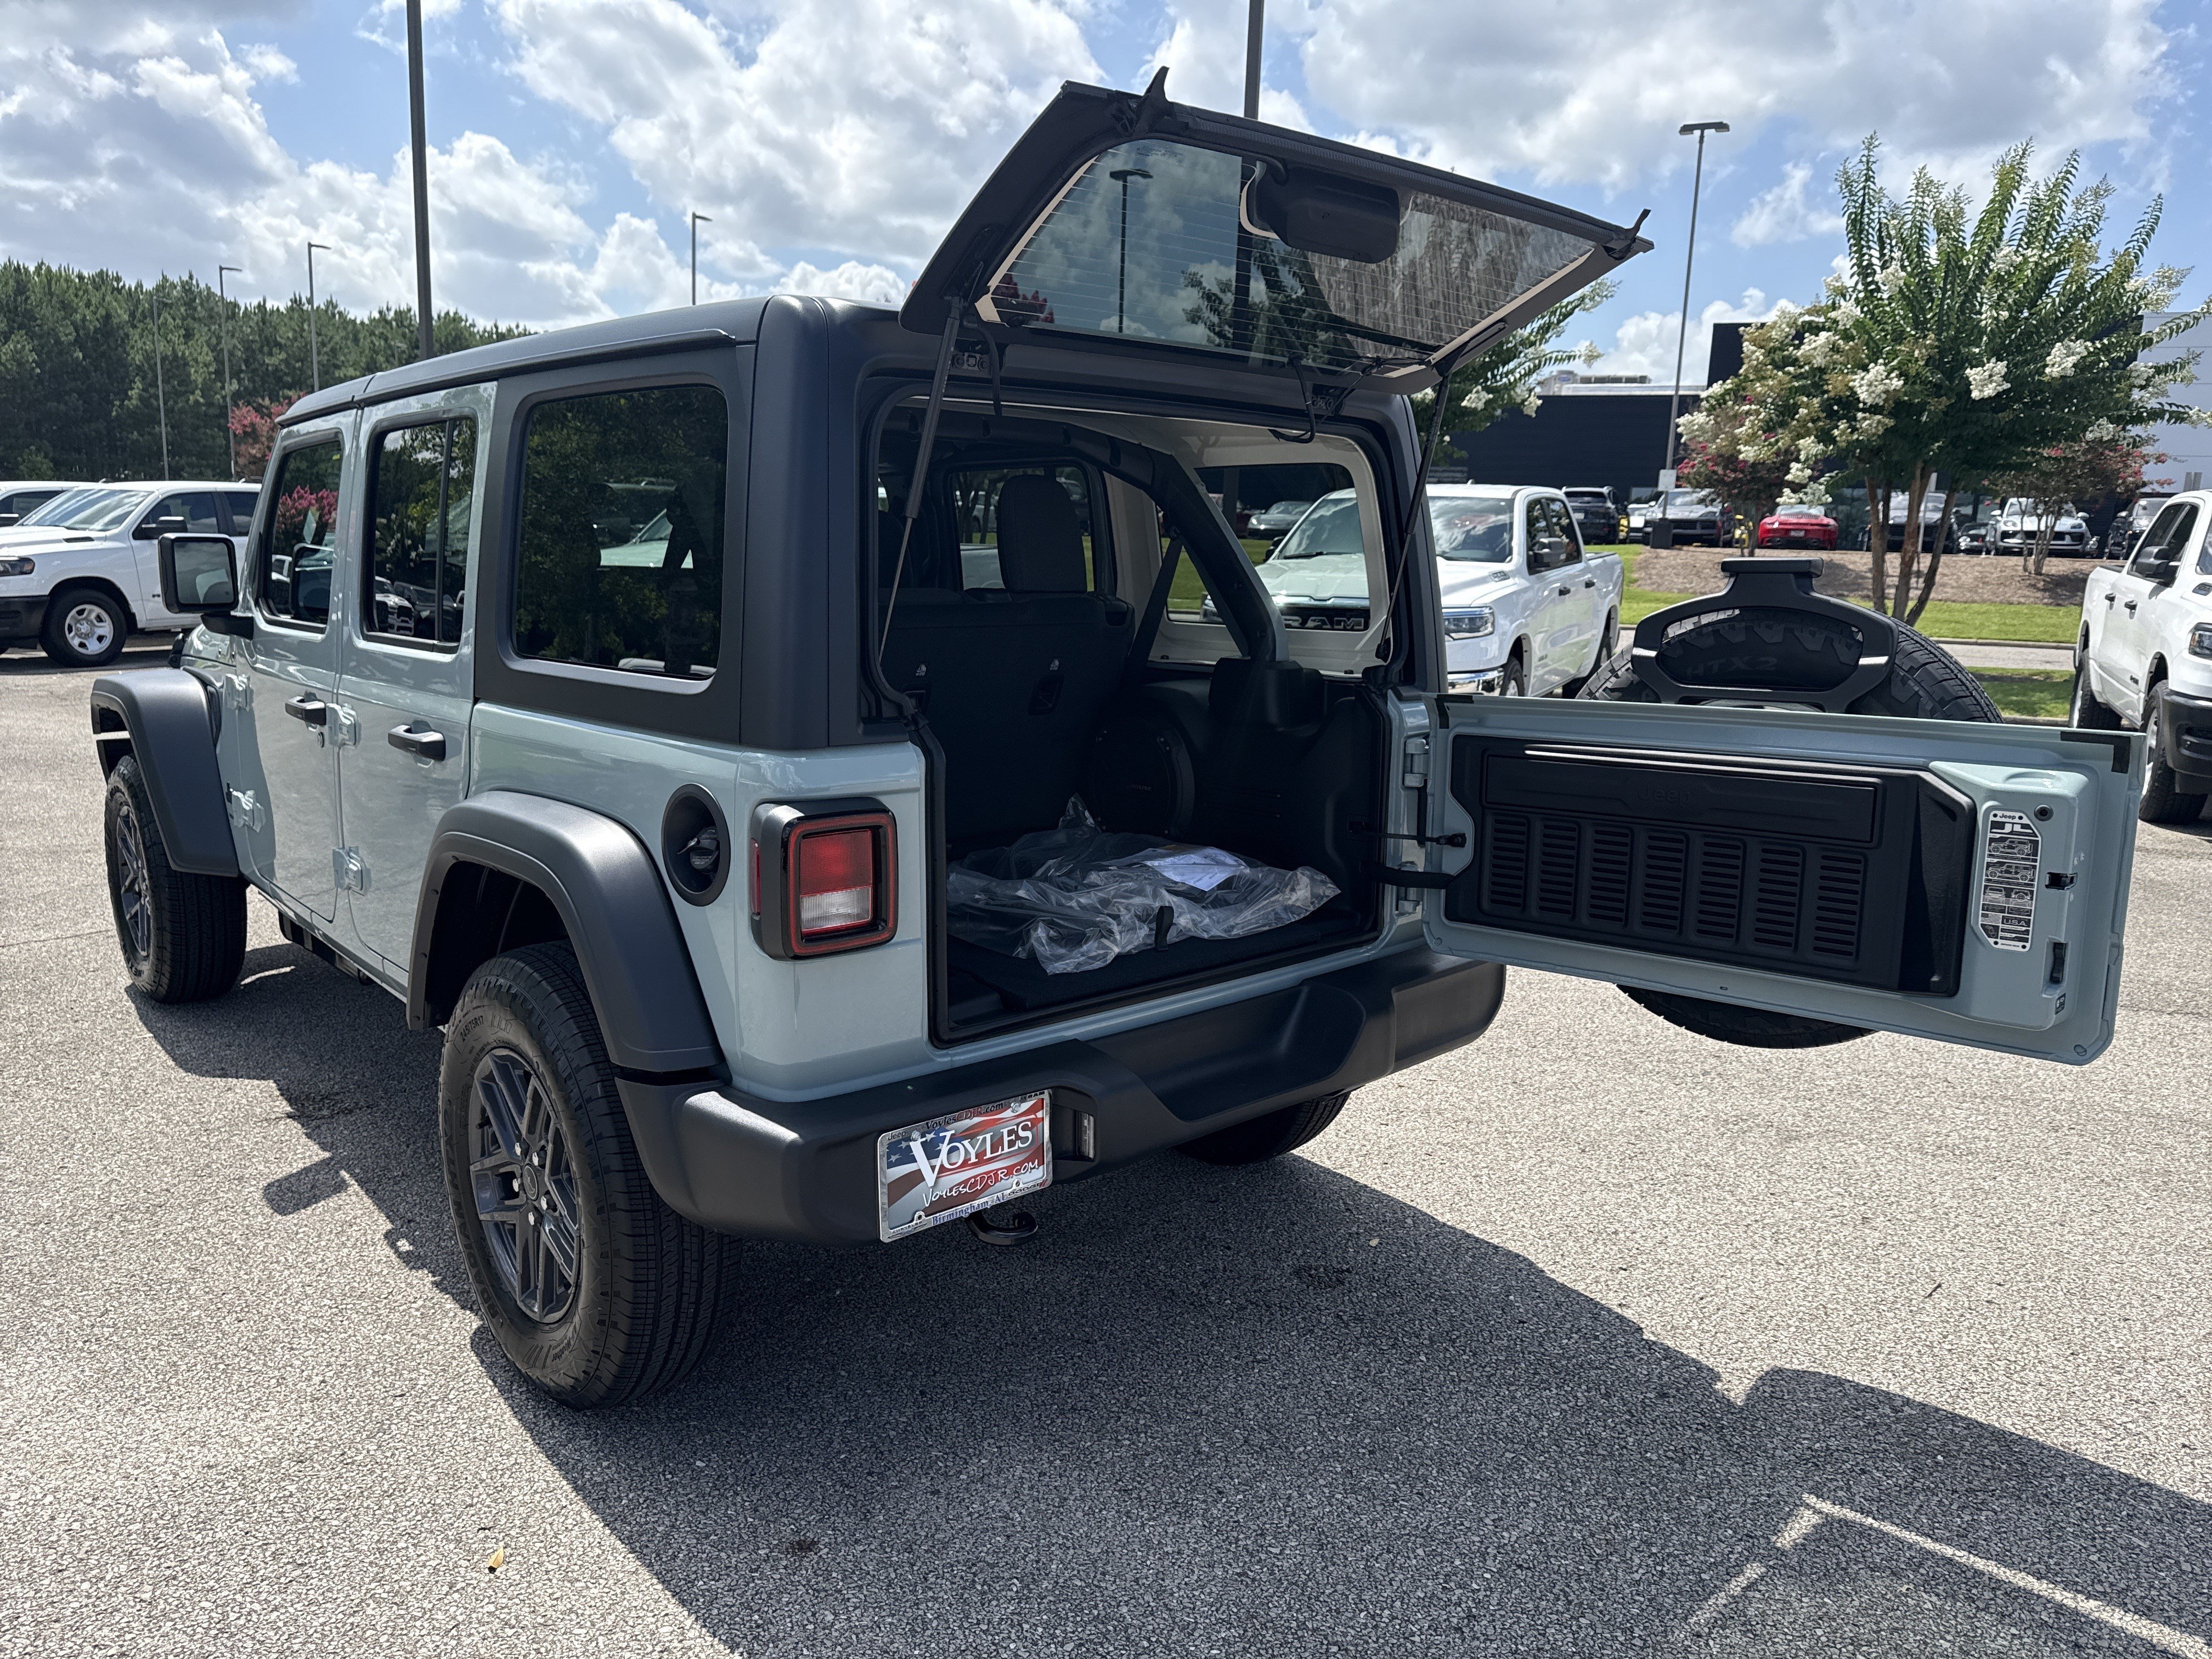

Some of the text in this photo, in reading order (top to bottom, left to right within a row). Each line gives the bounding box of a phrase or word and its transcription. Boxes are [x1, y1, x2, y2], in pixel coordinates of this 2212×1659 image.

[1281, 615, 1364, 629] RAM
[1638, 785, 1690, 808] Jeep
[1990, 822, 2034, 833] JL
[460, 1015, 484, 1042] 245/75R17
[887, 1131, 906, 1141] Jeep
[910, 1121, 1032, 1188] VOYLES
[932, 1192, 1007, 1226] Birmingham, AL
